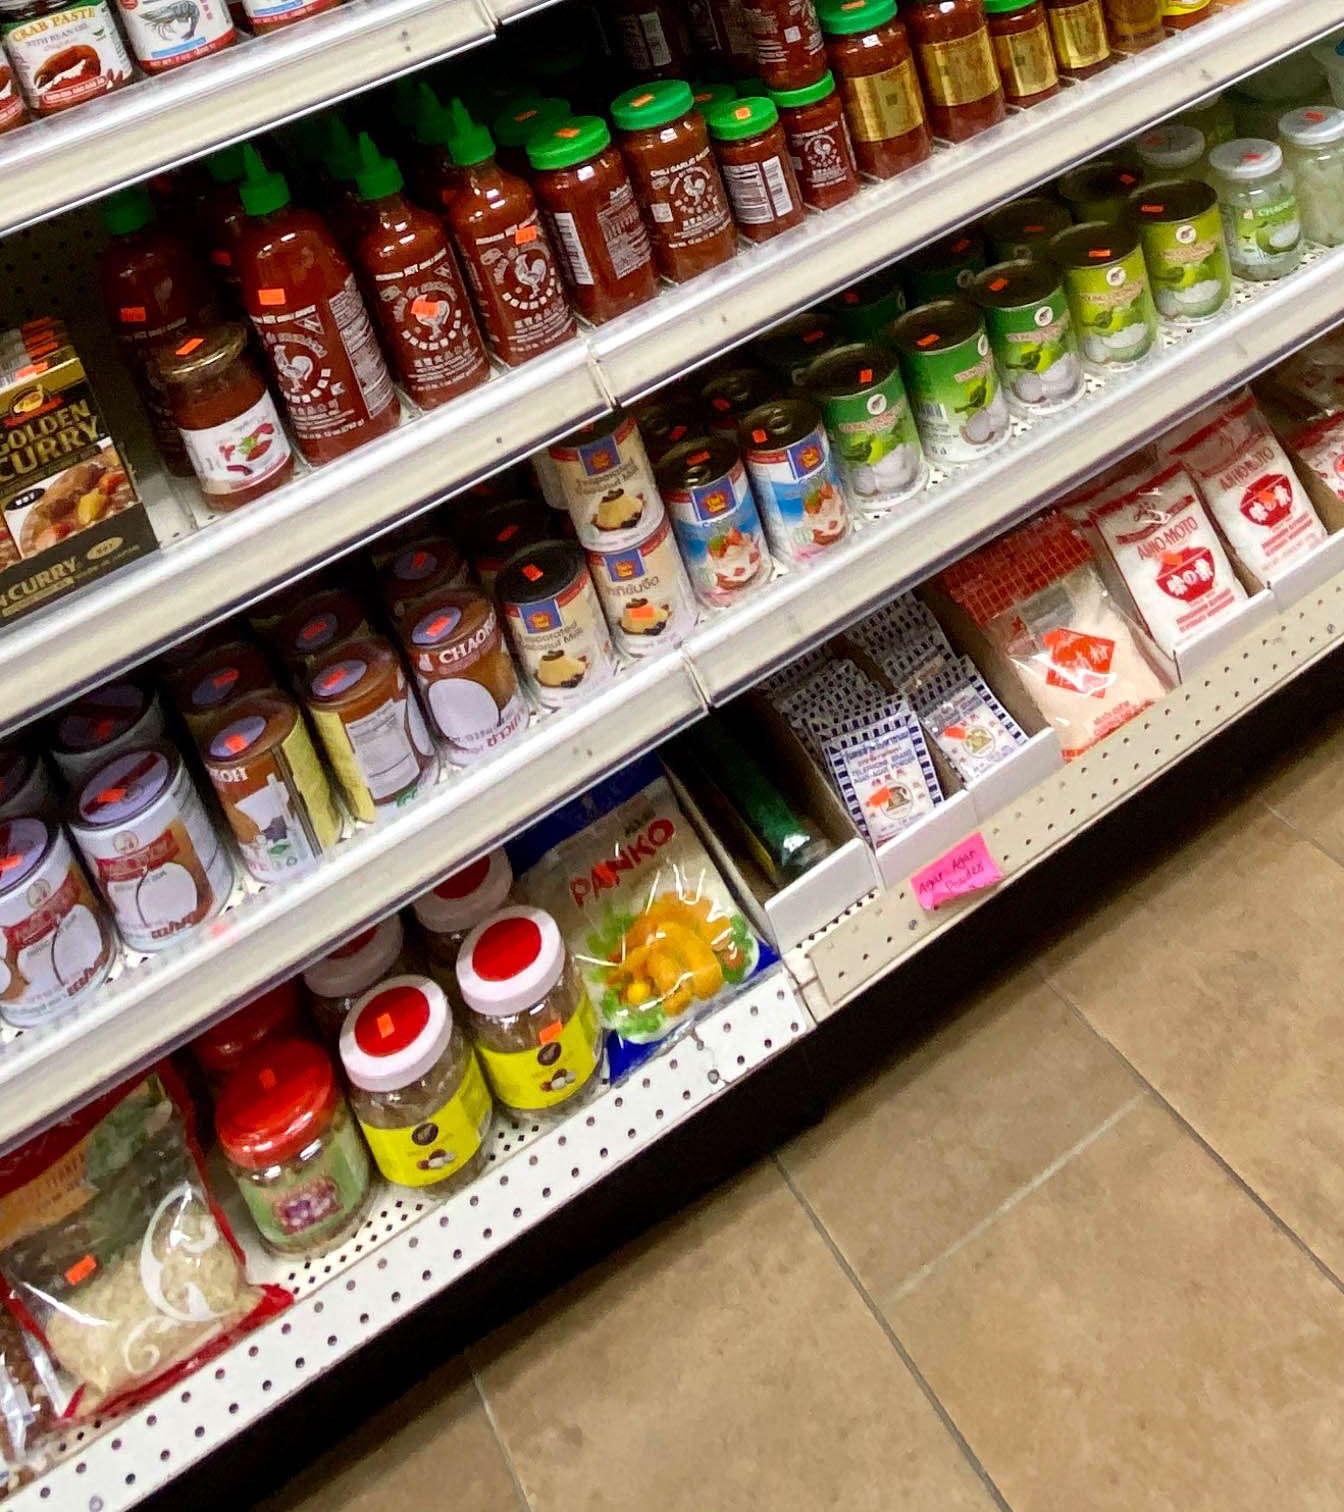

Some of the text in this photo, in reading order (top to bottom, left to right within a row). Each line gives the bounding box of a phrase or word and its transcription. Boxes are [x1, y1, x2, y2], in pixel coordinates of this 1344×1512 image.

[12, 6, 96, 44] CRAB PASTE
[7, 556, 79, 602] CURRY
[569, 818, 676, 908] PANKO
